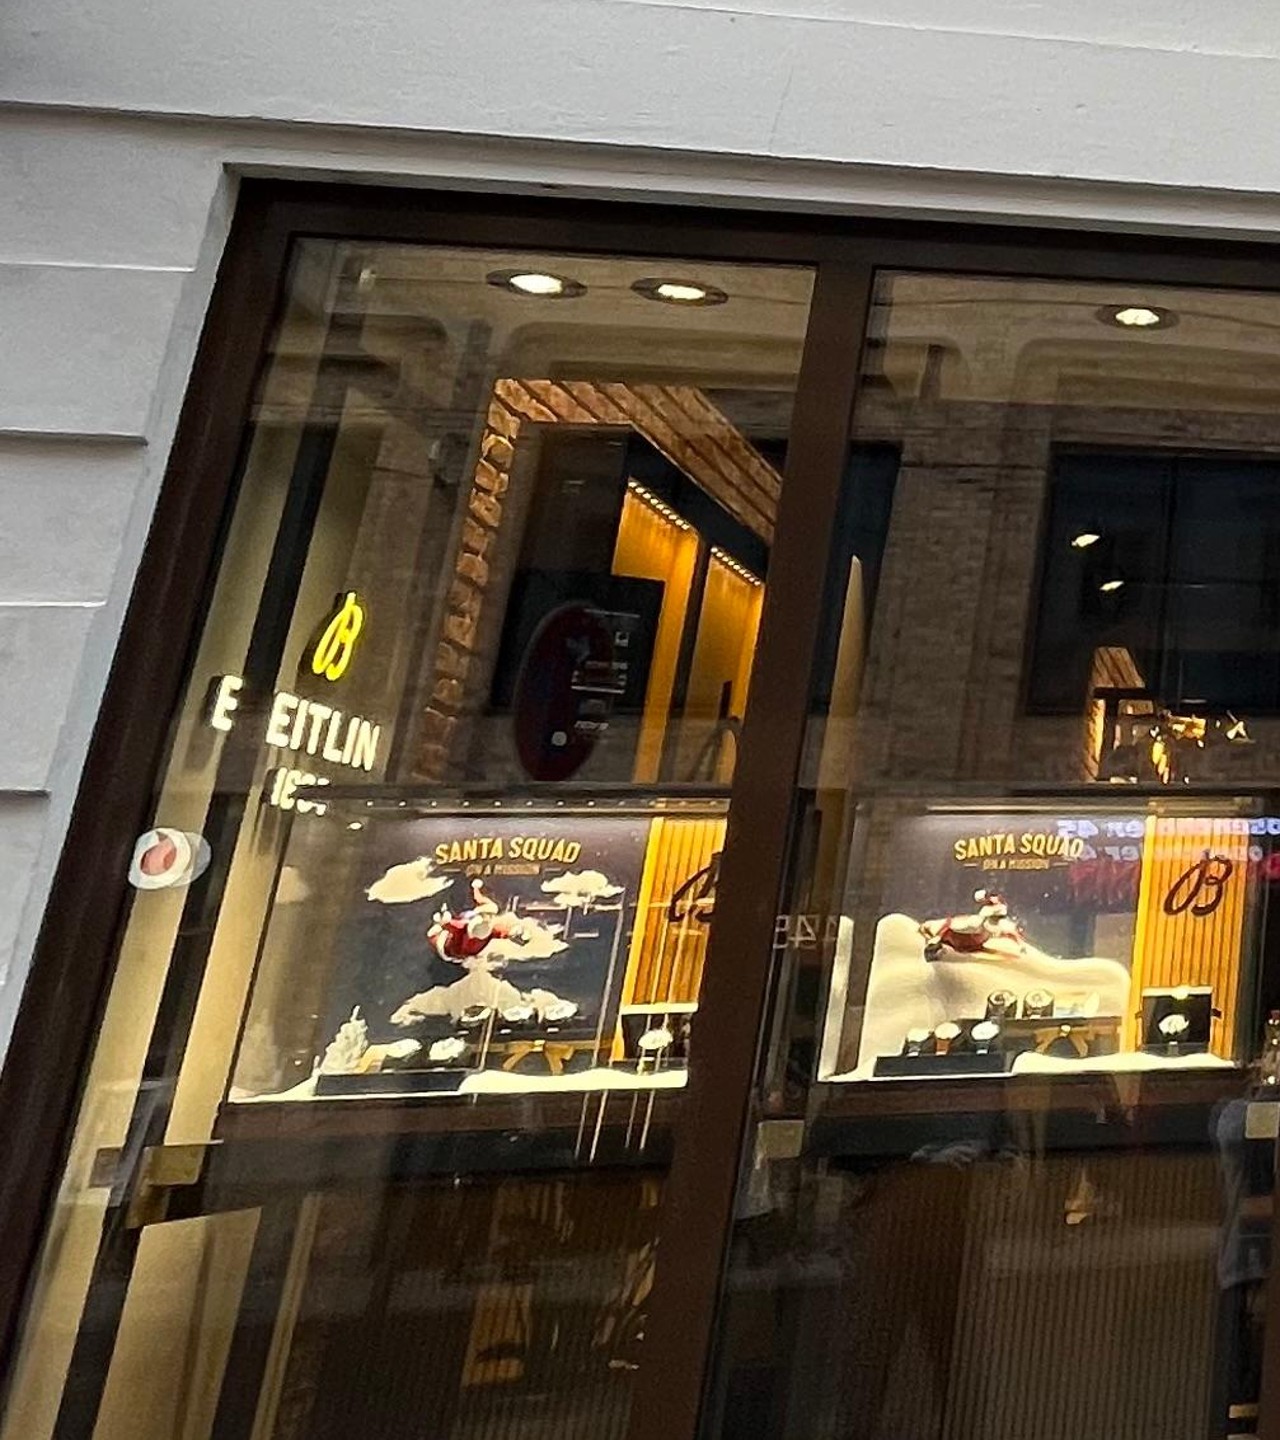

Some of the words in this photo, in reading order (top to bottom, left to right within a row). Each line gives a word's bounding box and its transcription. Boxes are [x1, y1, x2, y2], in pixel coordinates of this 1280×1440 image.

[435, 839, 503, 864] SANTA
[508, 836, 581, 864] SQUAD
[954, 833, 1015, 860] SANTA
[1020, 832, 1084, 858] SQUAD
